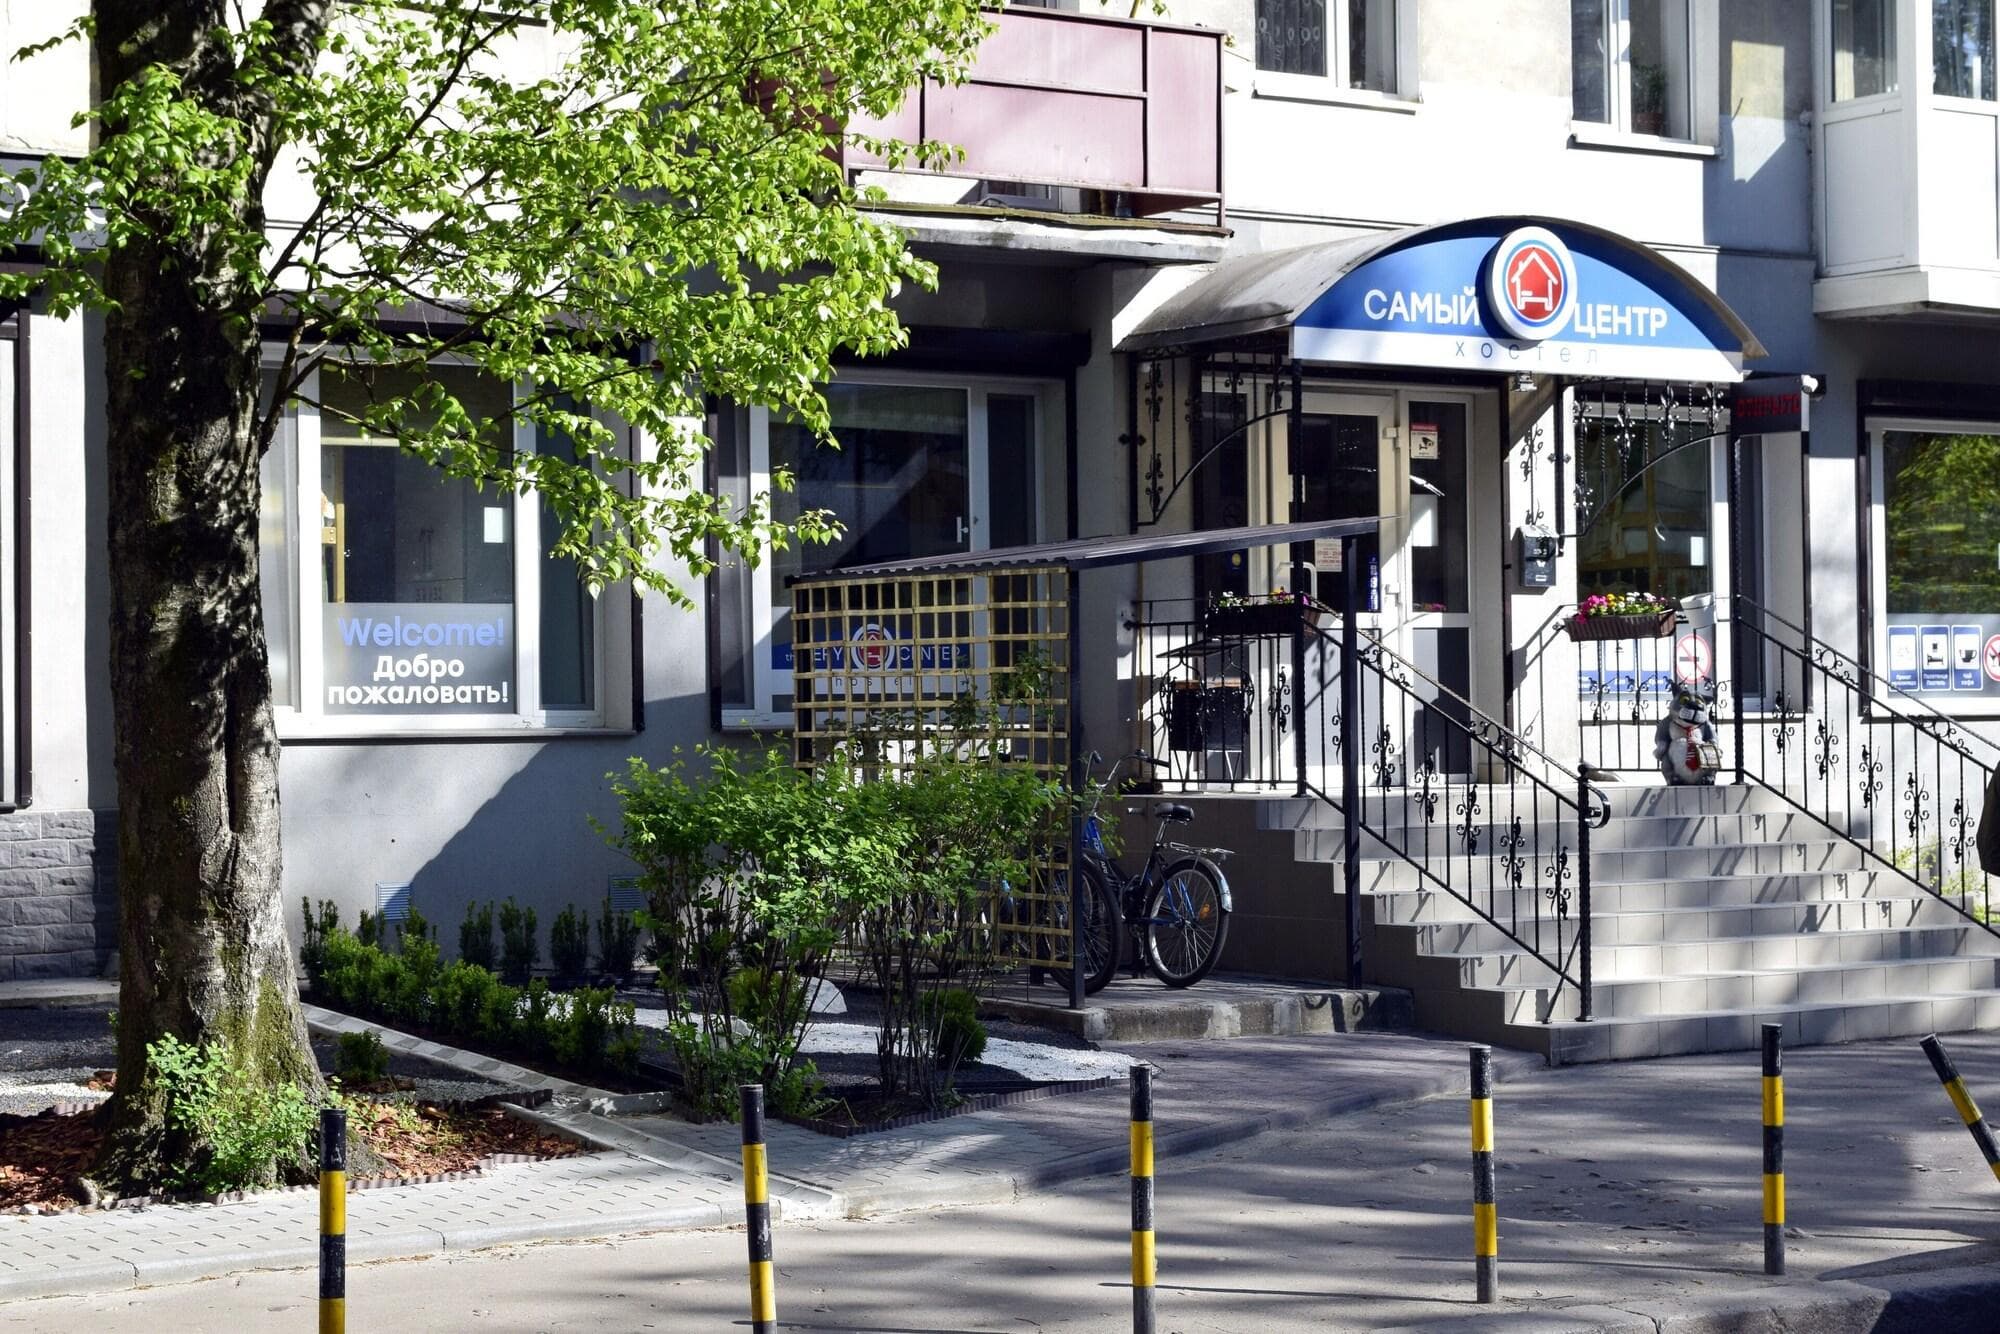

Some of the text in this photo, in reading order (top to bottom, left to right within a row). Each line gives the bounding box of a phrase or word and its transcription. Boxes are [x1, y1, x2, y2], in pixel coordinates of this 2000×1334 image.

[1363, 285, 1668, 339] САМЫЙ ЦЕНТР
[338, 616, 504, 647] Welcome!
[373, 653, 465, 684] Добро
[328, 682, 508, 705] пожаловать!
